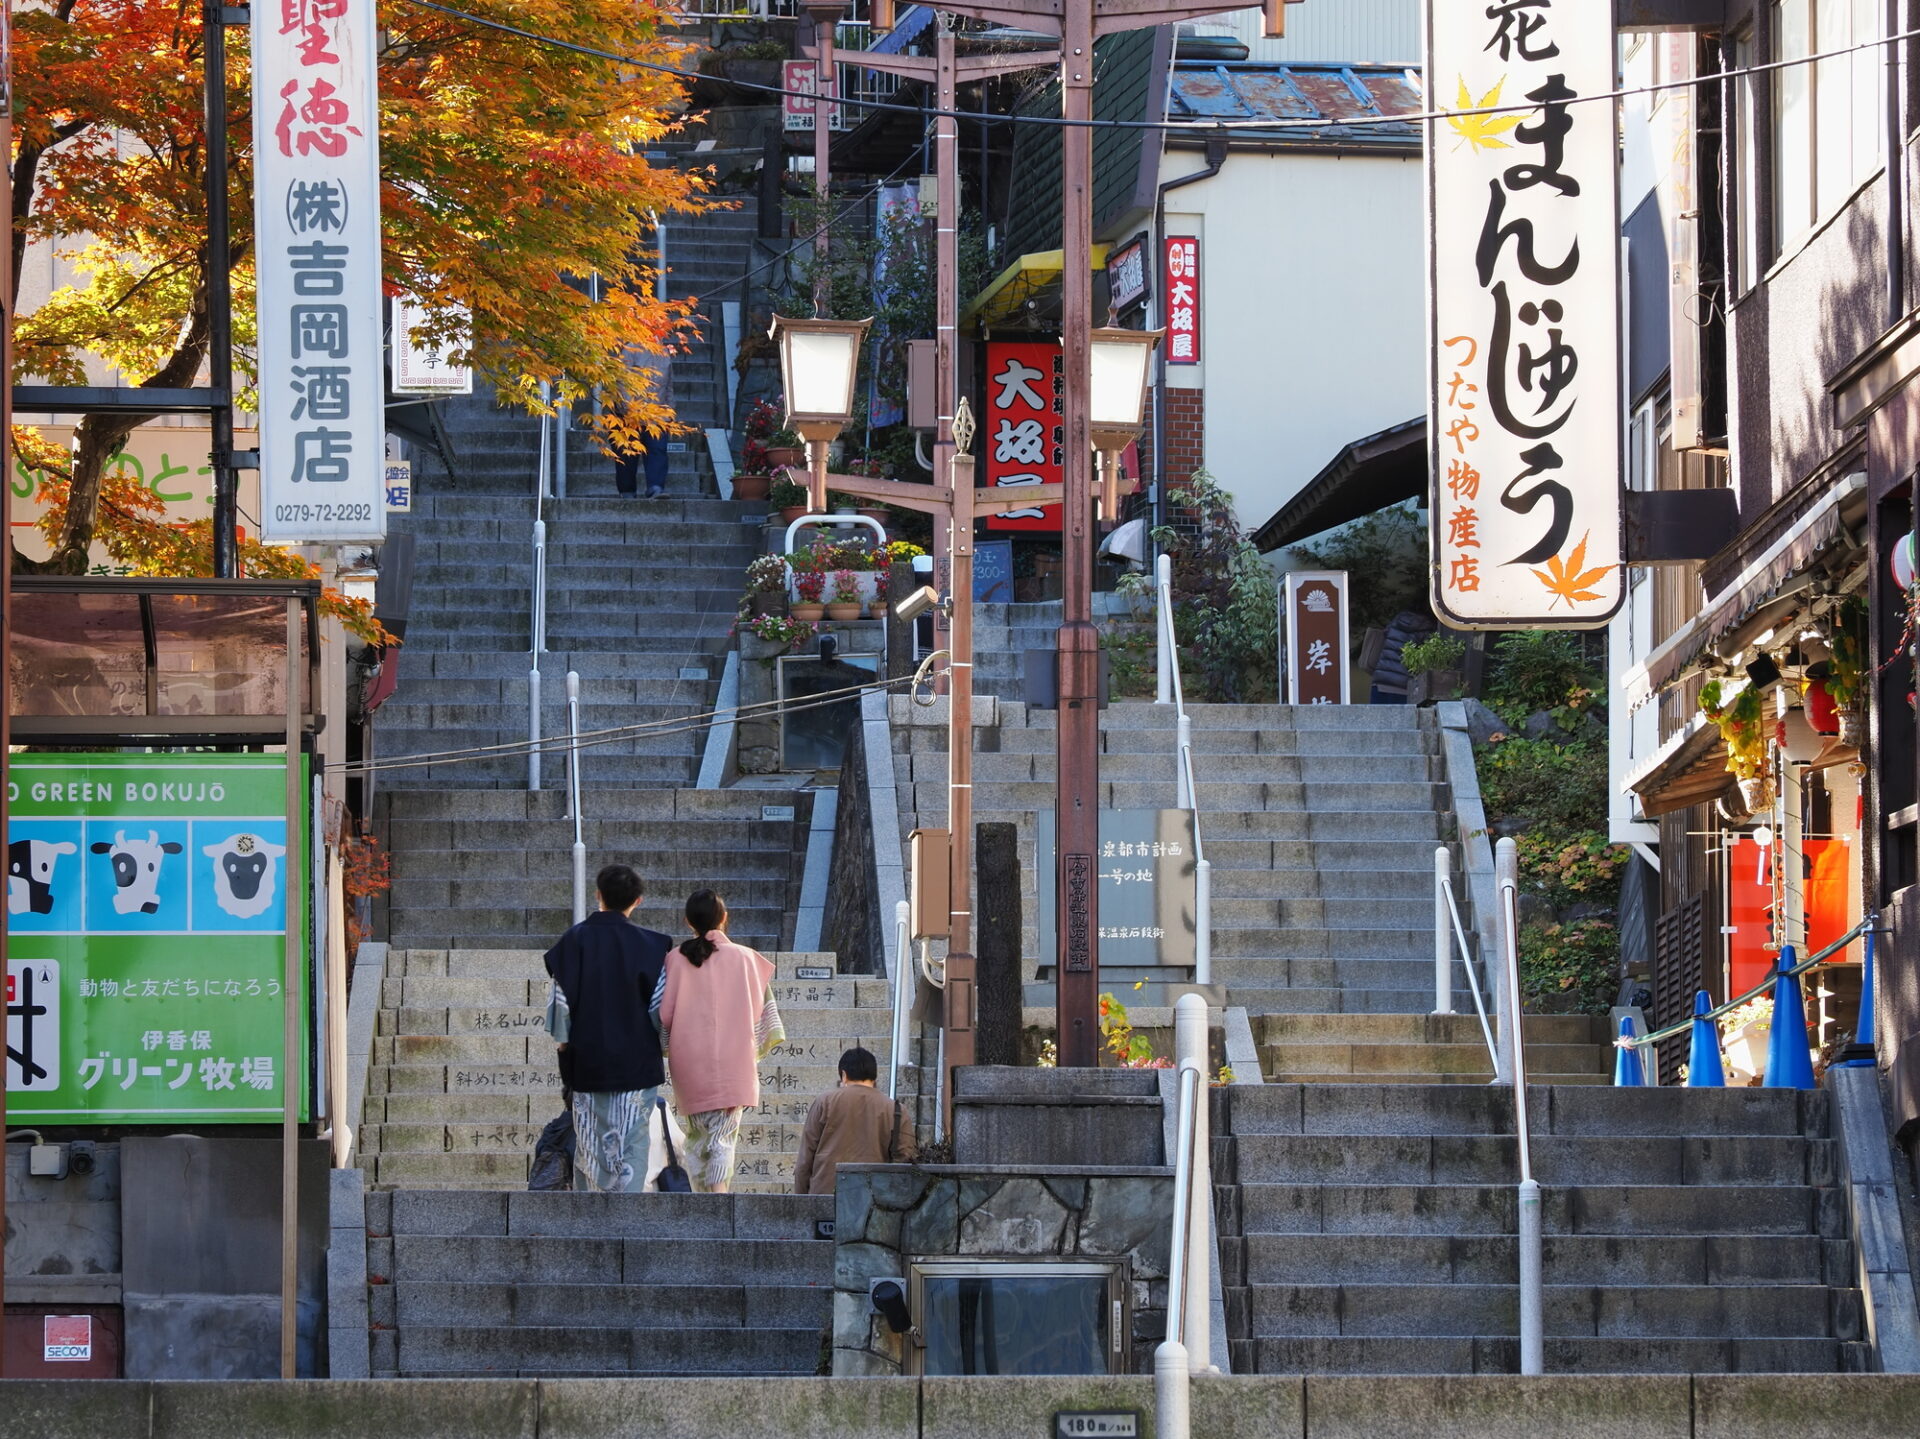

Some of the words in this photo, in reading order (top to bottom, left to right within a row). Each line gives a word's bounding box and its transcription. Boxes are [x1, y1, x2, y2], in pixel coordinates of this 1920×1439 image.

[1443, 335, 1482, 593] つたや物産店
[275, 503, 372, 522] 0279-72-2292
[31, 782, 112, 801] GREEN
[125, 782, 225, 801] BOKUJŌ
[1098, 840, 1183, 858] 泉都市計画
[79, 977, 282, 997] 動物と友だちになろう
[474, 1012, 545, 1030] 榛名山の
[141, 1030, 213, 1051] 伊香保
[78, 1052, 276, 1091] グリーン牧場
[736, 1159, 797, 1177] 全體を
[47, 1346, 88, 1357] SECOM
